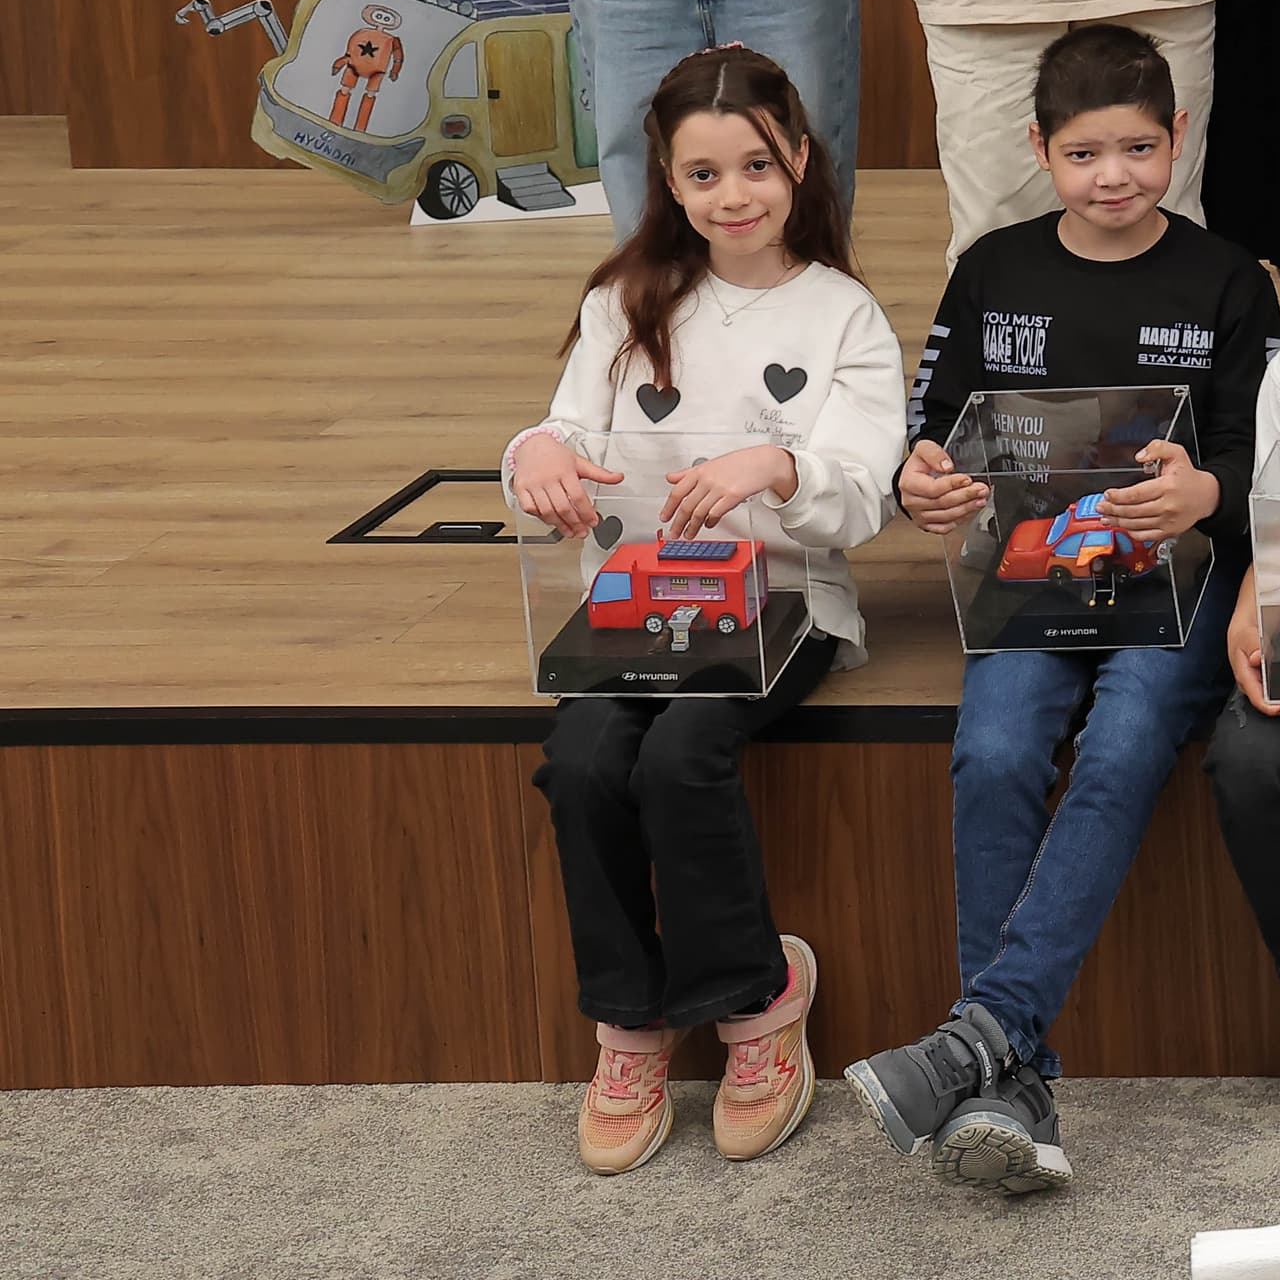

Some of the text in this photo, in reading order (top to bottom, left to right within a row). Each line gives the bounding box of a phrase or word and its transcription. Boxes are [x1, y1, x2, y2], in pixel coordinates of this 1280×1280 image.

[294, 132, 356, 166] HYUNDAI
[983, 311, 1053, 329] YOU MUST
[1015, 326, 1046, 367] YOUR
[1138, 326, 1181, 347] HARD
[1138, 353, 1178, 364] STAY
[984, 362, 1048, 376] WN DECISIONS
[991, 413, 1044, 436] HEN YOU
[1012, 439, 1049, 459] KNOW
[1060, 628, 1098, 636] HYUNDAI
